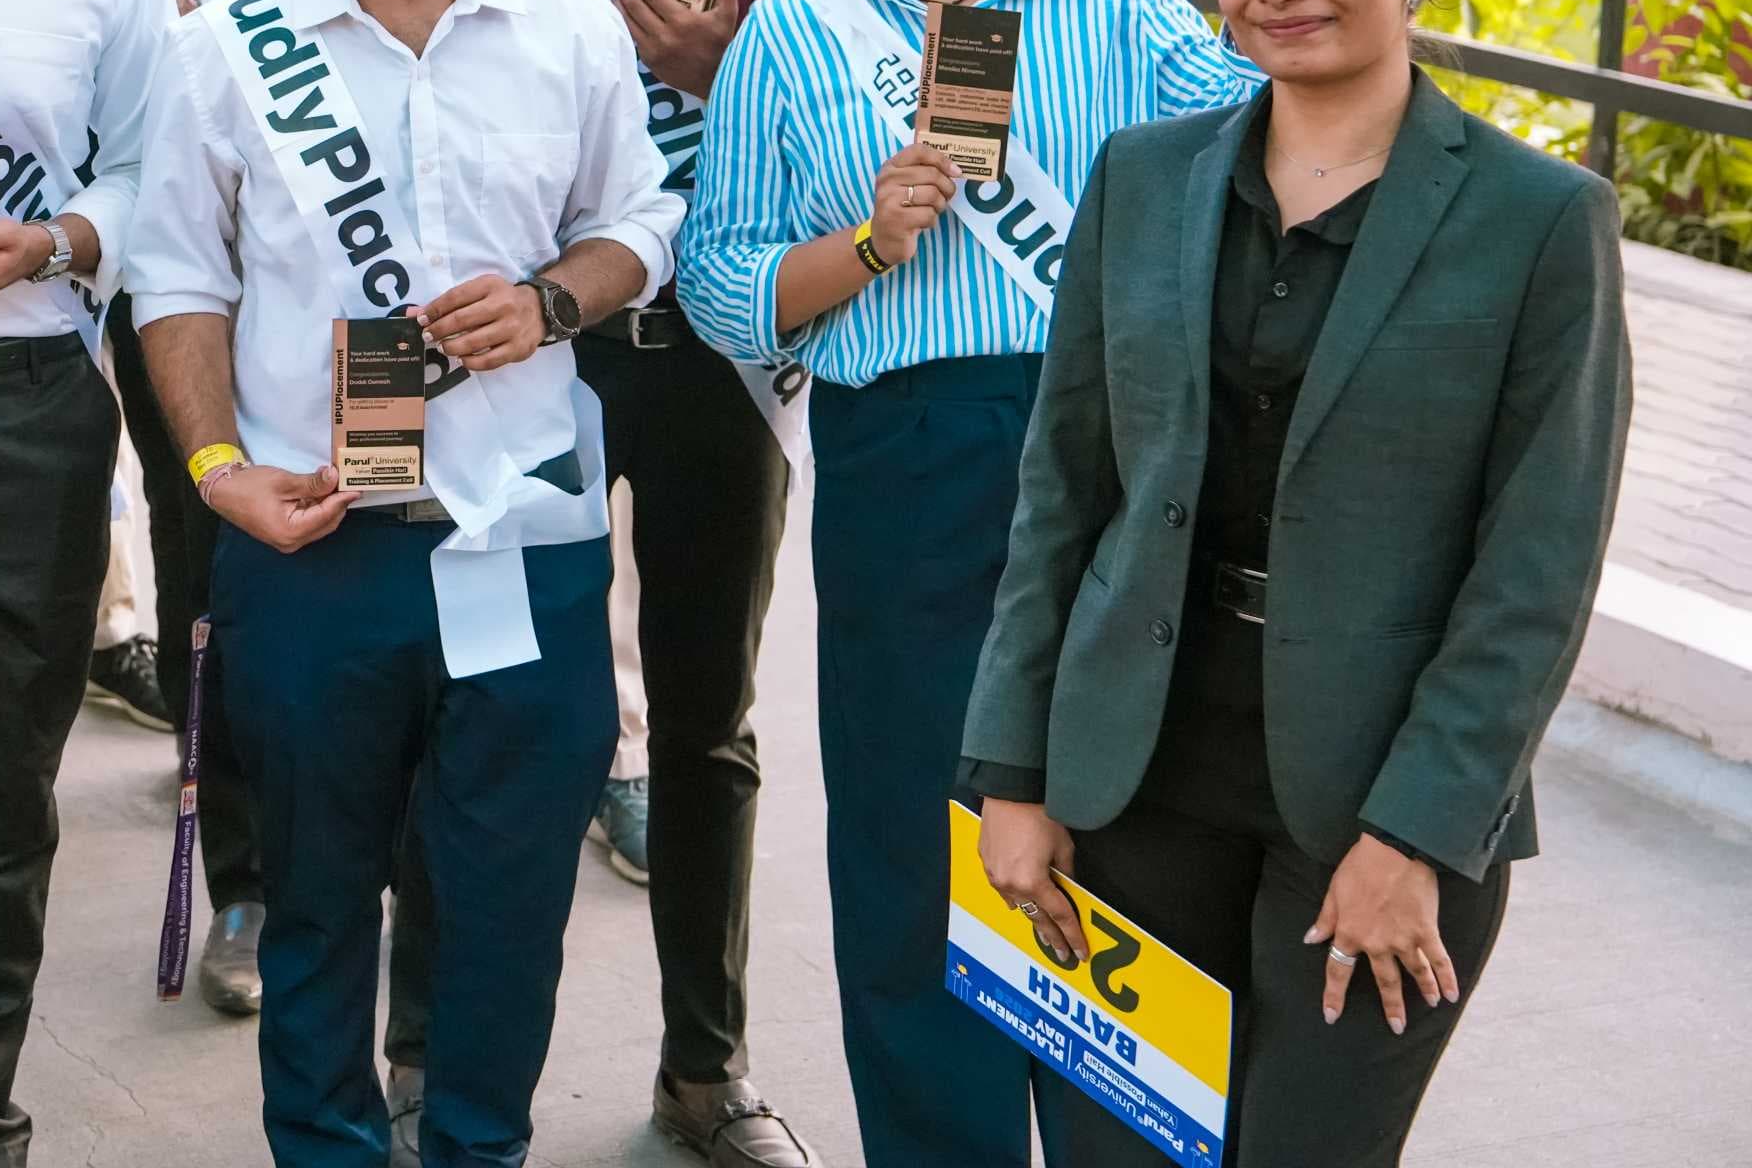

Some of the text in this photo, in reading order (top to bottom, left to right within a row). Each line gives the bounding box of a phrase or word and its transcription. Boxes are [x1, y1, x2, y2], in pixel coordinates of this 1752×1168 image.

[920, 32, 937, 108] #PUPlacement
[335, 349, 344, 424] #PUPlacement
[375, 456, 417, 466] University
[171, 821, 192, 987] Faculty of Engineering & Technology
[976, 990, 1065, 1063] PLACEMENT
[1027, 964, 1138, 1067] BATCH
[1035, 1018, 1066, 1047] DAY
[1074, 1062, 1137, 1118] University
[1085, 1051, 1177, 1125] Yahan Possible Hai!
